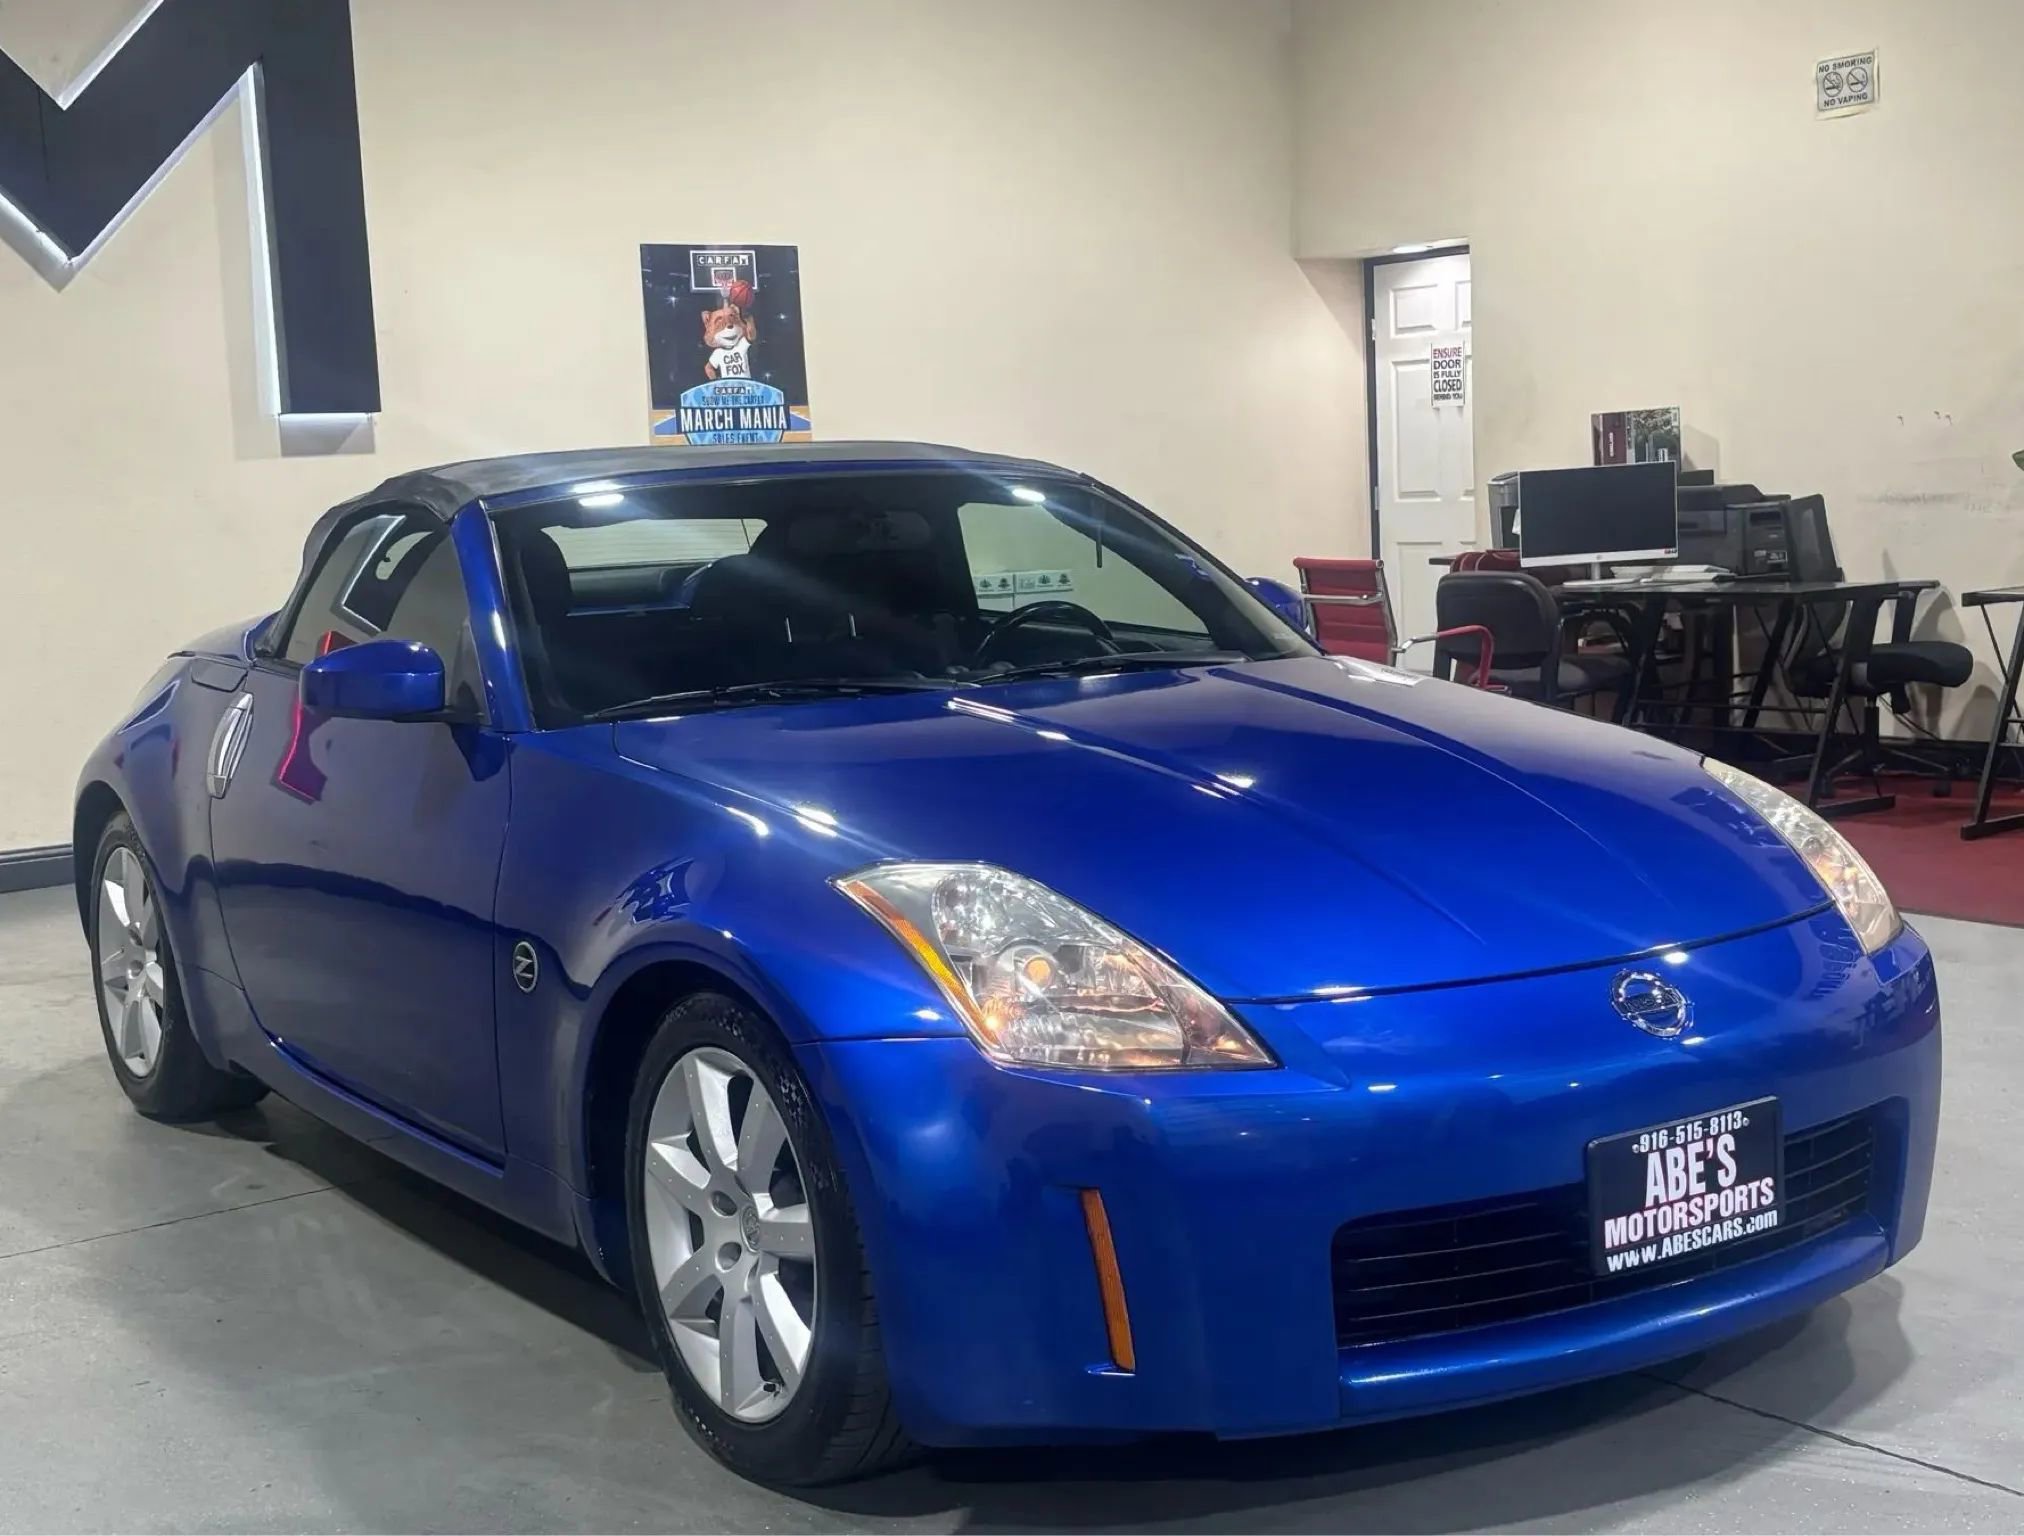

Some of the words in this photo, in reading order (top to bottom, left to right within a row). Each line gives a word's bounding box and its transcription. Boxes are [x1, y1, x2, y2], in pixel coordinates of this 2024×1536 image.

[1818, 64, 1830, 73] NO
[1832, 56, 1873, 71] SMOKING
[1823, 98, 1836, 108] NO
[1837, 92, 1868, 105] VAPING
[723, 352, 743, 365] CAR
[1433, 346, 1462, 359] ENSURE
[725, 364, 745, 376] FOX
[1433, 359, 1461, 370] DOOR
[1433, 371, 1440, 379] IS
[1441, 370, 1461, 379] FULLY
[1433, 379, 1463, 392] CLOSED
[680, 407, 734, 432] MARCH
[739, 405, 788, 430] MANIA
[515, 955, 534, 978] Z
[1639, 1110, 1743, 1153] 916-515-8113
[1645, 1133, 1737, 1208] ABE'S
[1604, 1177, 1775, 1249] MOTORSPORTS
